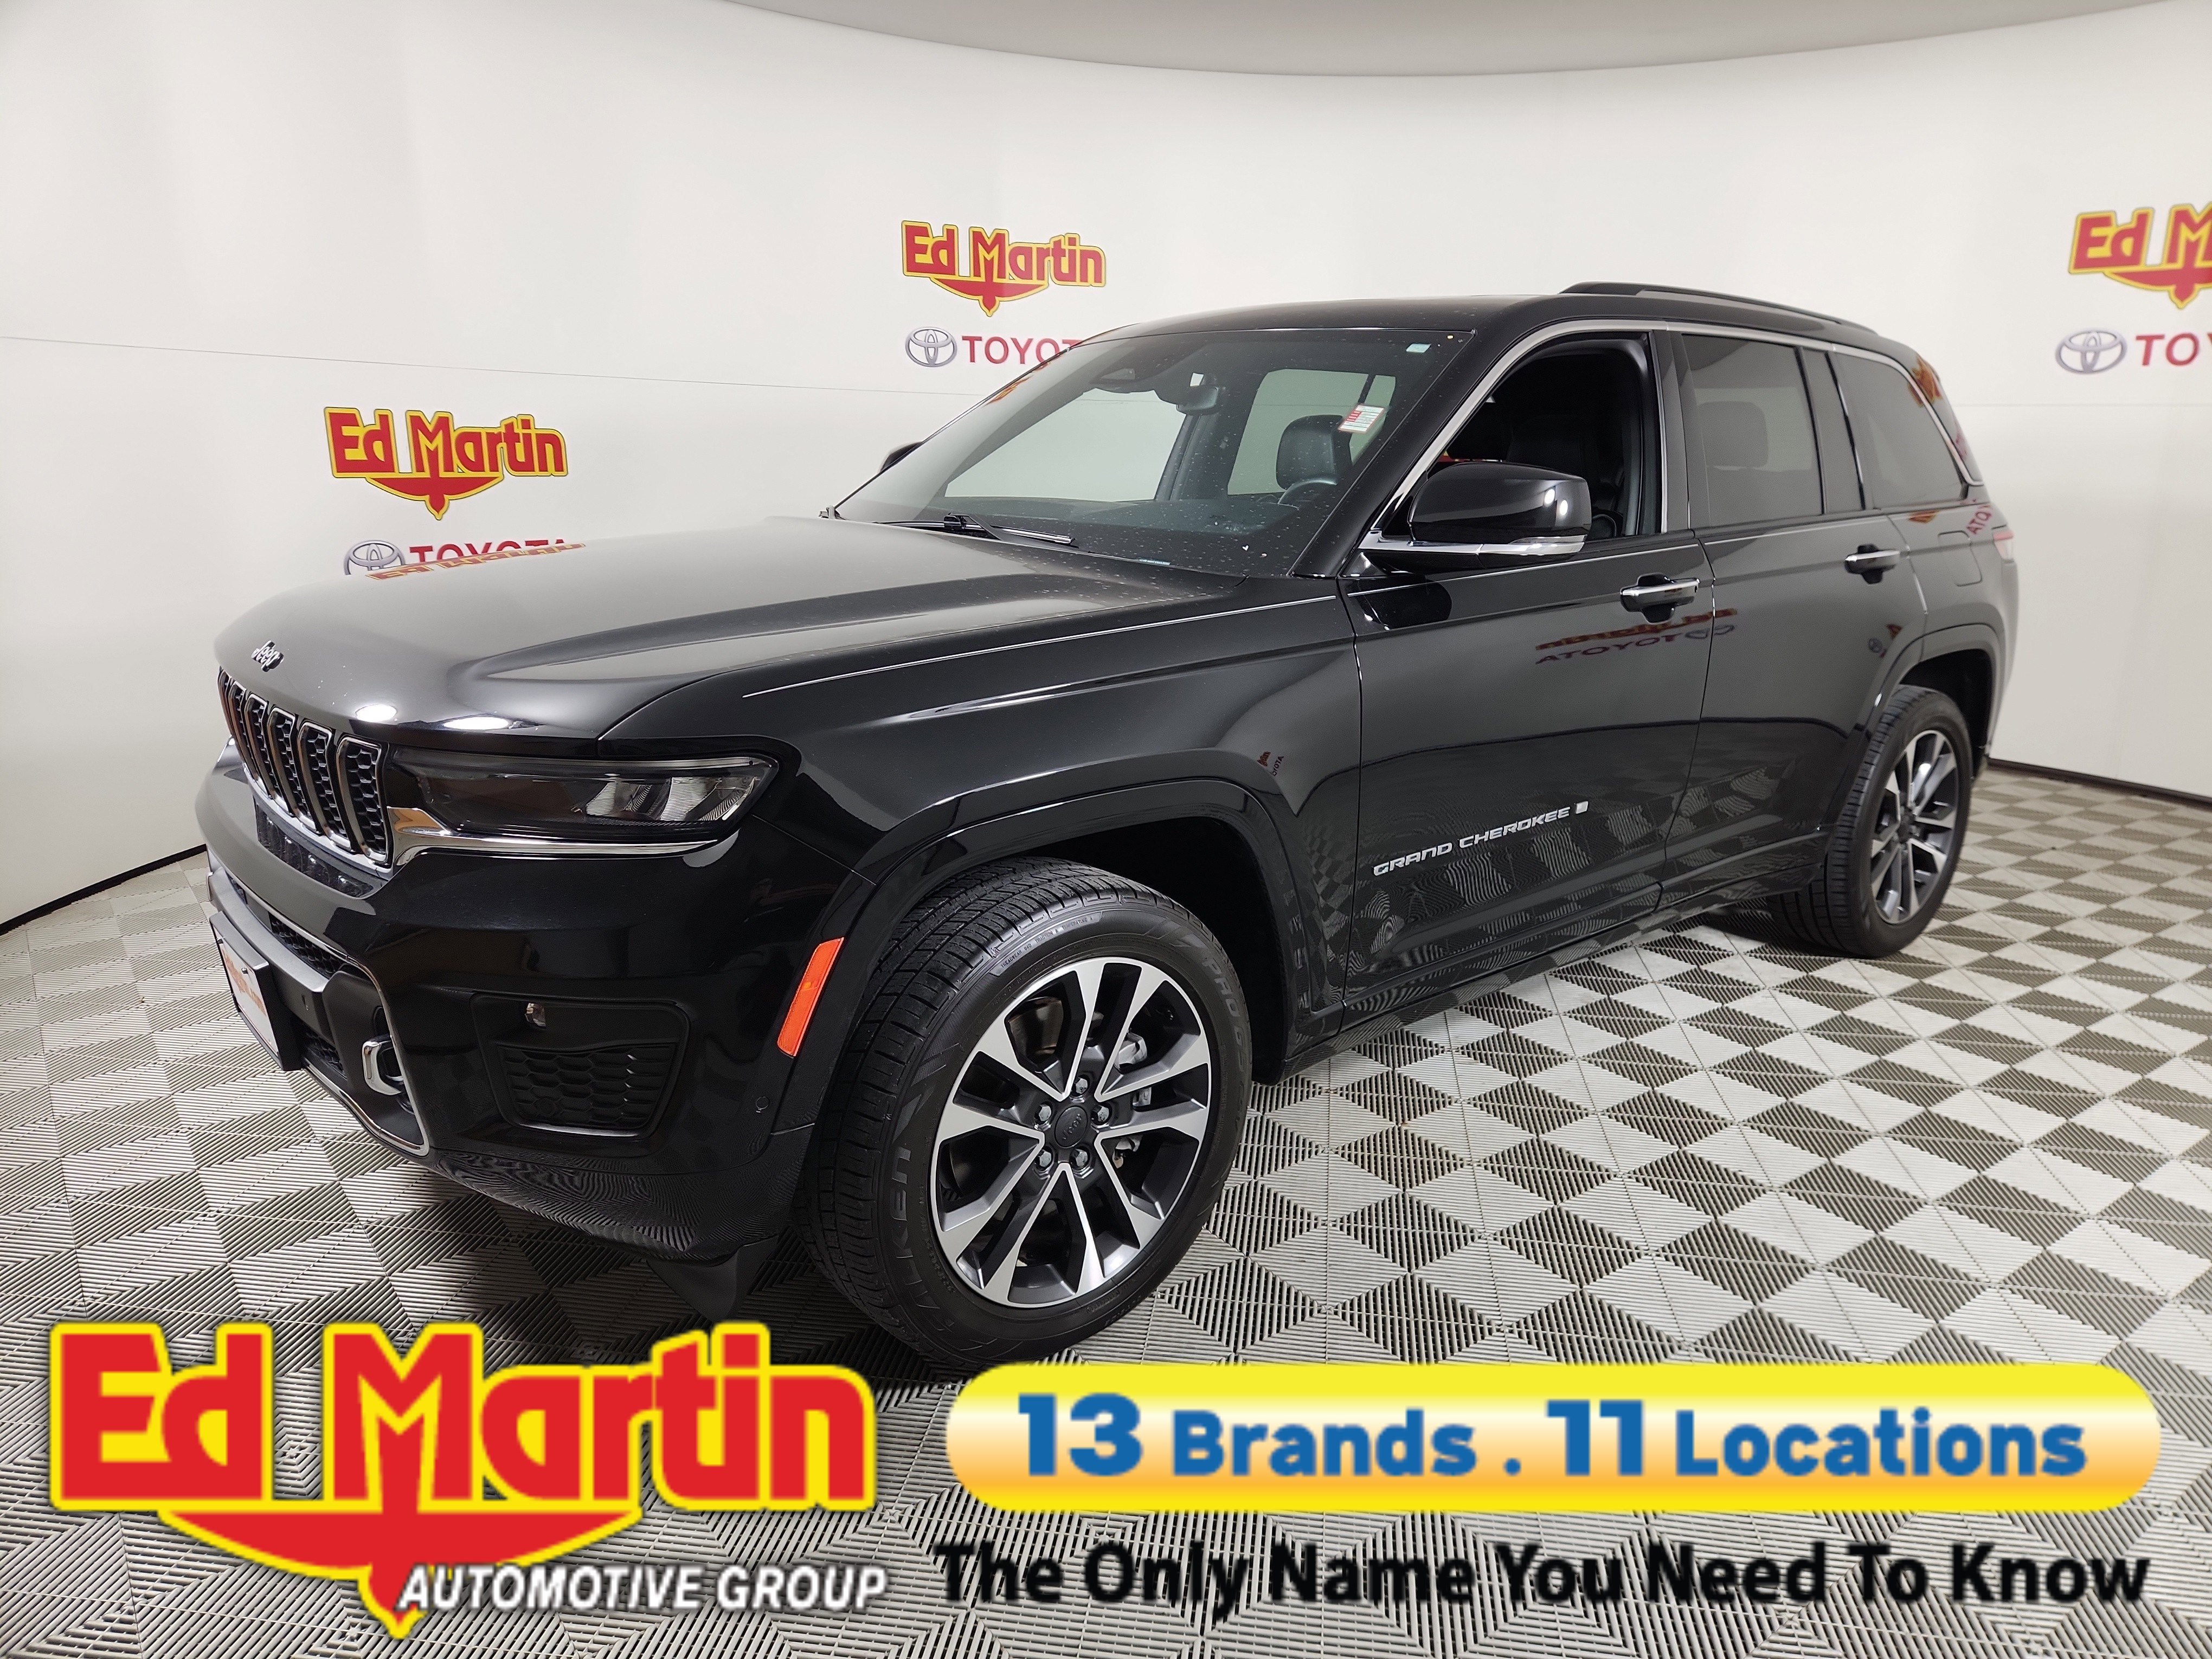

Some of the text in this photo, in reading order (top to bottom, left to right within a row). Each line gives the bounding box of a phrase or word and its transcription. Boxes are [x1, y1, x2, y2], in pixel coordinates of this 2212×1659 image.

[902, 221, 1105, 286] Ed Martin
[2069, 209, 2153, 273] Ed
[325, 408, 568, 477] Ed Martin
[1373, 806, 1571, 876] GRAND CHEROKEE
